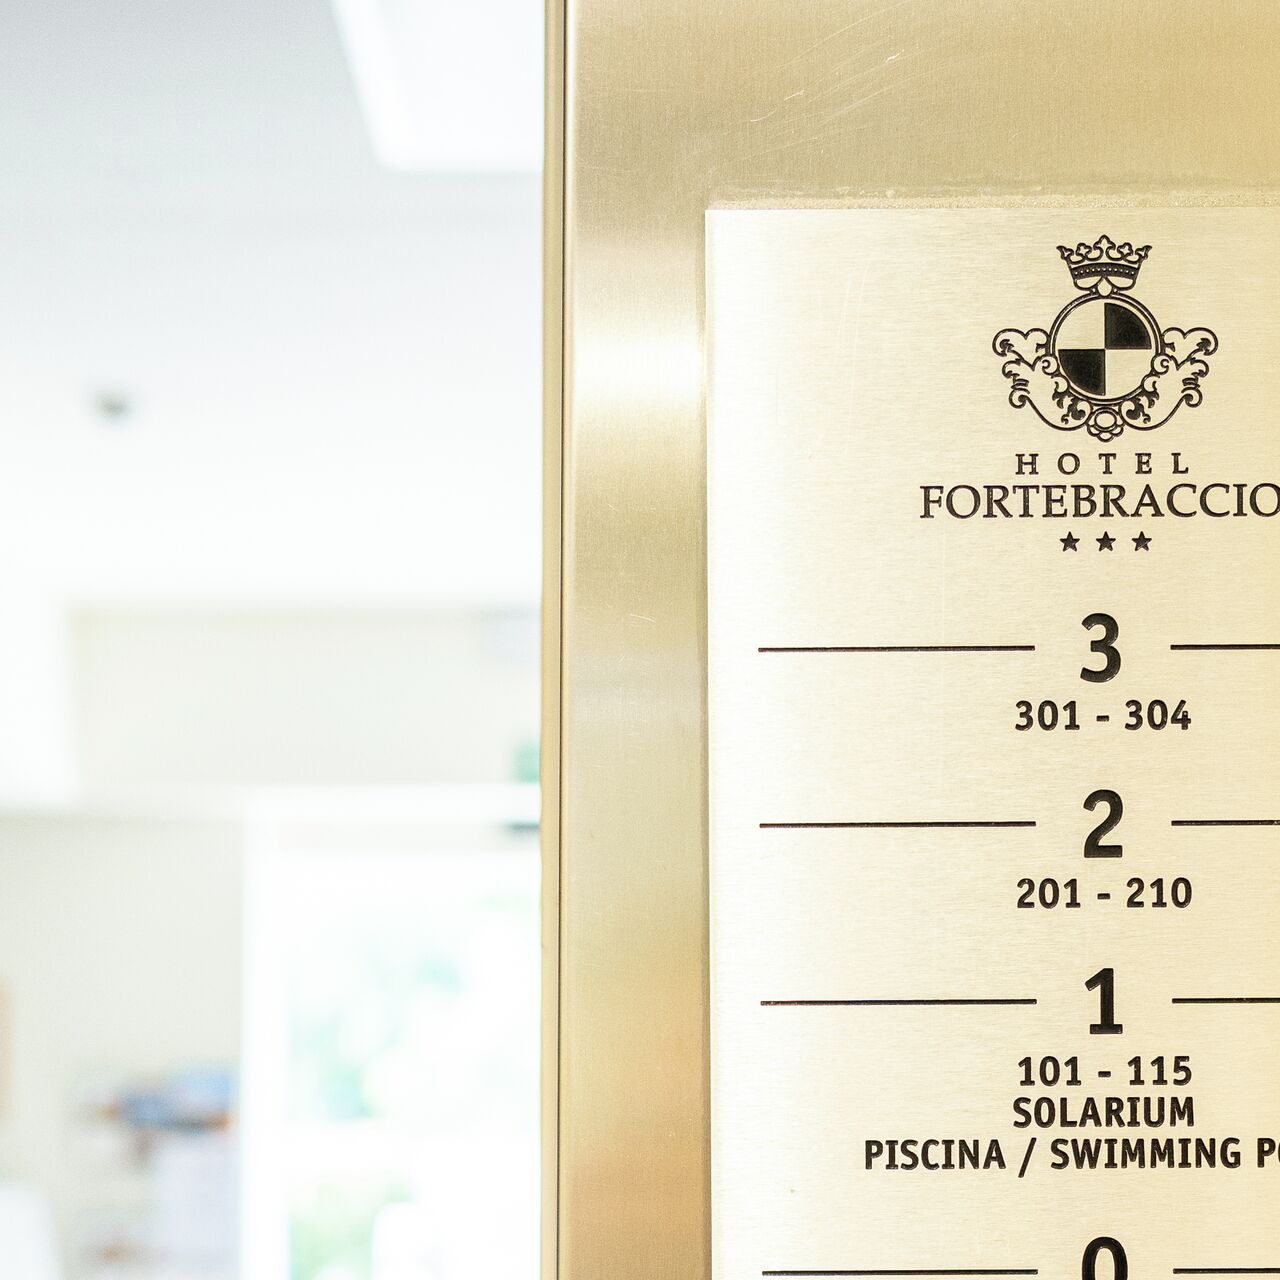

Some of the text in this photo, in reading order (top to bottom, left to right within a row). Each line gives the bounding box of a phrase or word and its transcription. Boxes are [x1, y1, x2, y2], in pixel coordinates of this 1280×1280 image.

[1015, 452, 1189, 476] HOTEL
[1079, 612, 1122, 684] 3
[1014, 700, 1080, 732] 301
[1124, 699, 1192, 731] 304
[1083, 789, 1124, 859] 2
[1016, 877, 1081, 909] 201
[1126, 876, 1193, 909] 210
[1084, 967, 1124, 1035] 1
[1017, 1055, 1082, 1087] 101
[1127, 1055, 1192, 1086] 115
[1012, 1096, 1195, 1129] SOLARIUM
[865, 1138, 1007, 1171] PISCINA
[1017, 1137, 1037, 1179] /
[1050, 1137, 1241, 1170] SWIMMING
